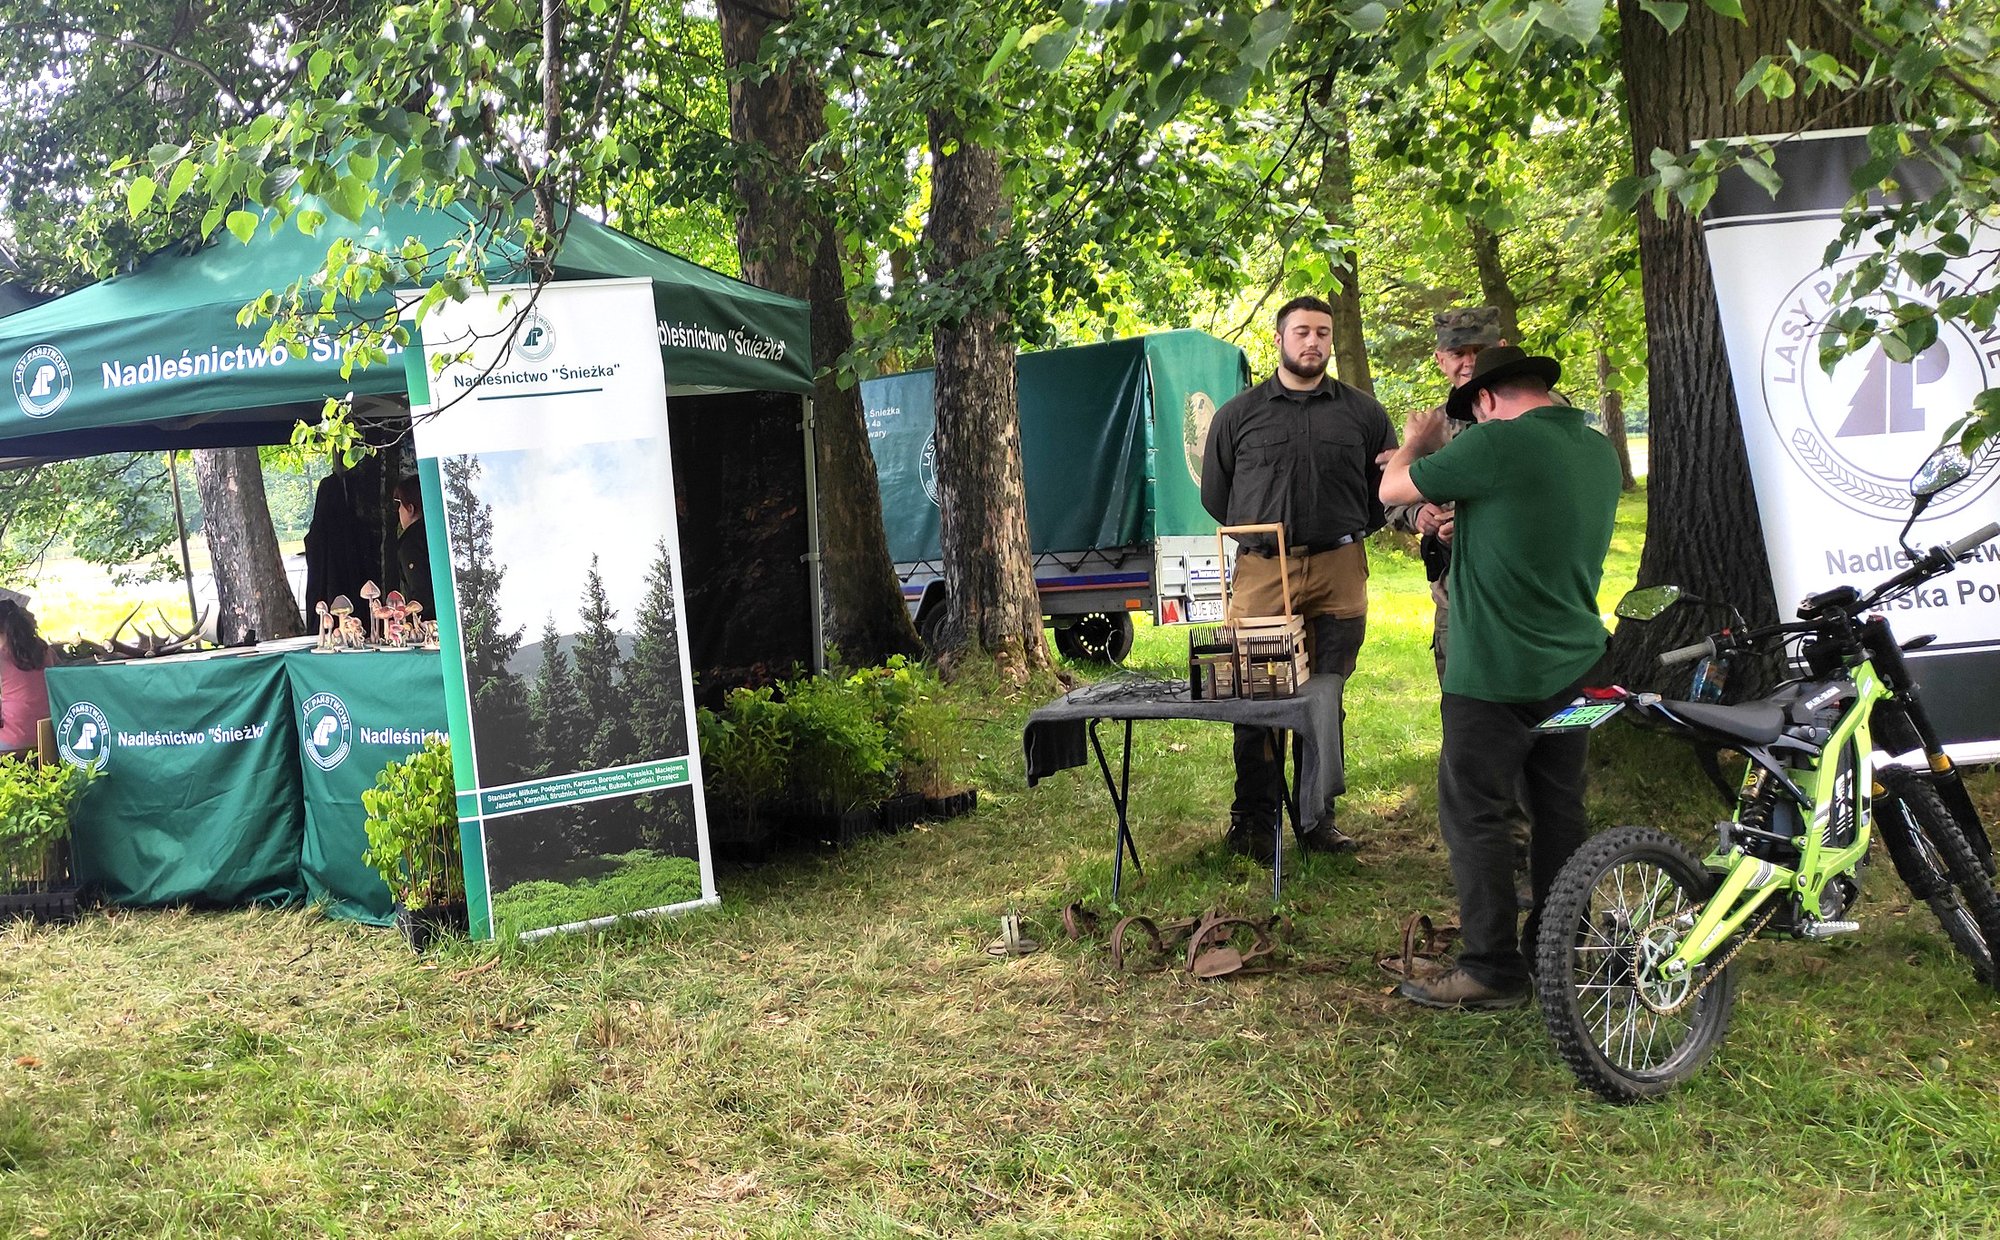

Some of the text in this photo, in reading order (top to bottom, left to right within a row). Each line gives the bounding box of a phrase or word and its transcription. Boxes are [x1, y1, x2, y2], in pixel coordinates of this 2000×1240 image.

[1774, 298, 1814, 384] LASY
[16, 347, 69, 383] LASY PAŃSTWOWE
[102, 343, 288, 389] Nadleśnictwo
[454, 363, 621, 388] Nadleśnictwo "Śnieżka"
[922, 439, 935, 467] LAS
[60, 712, 75, 734] LASY
[118, 730, 205, 746] Nadleśnictwo
